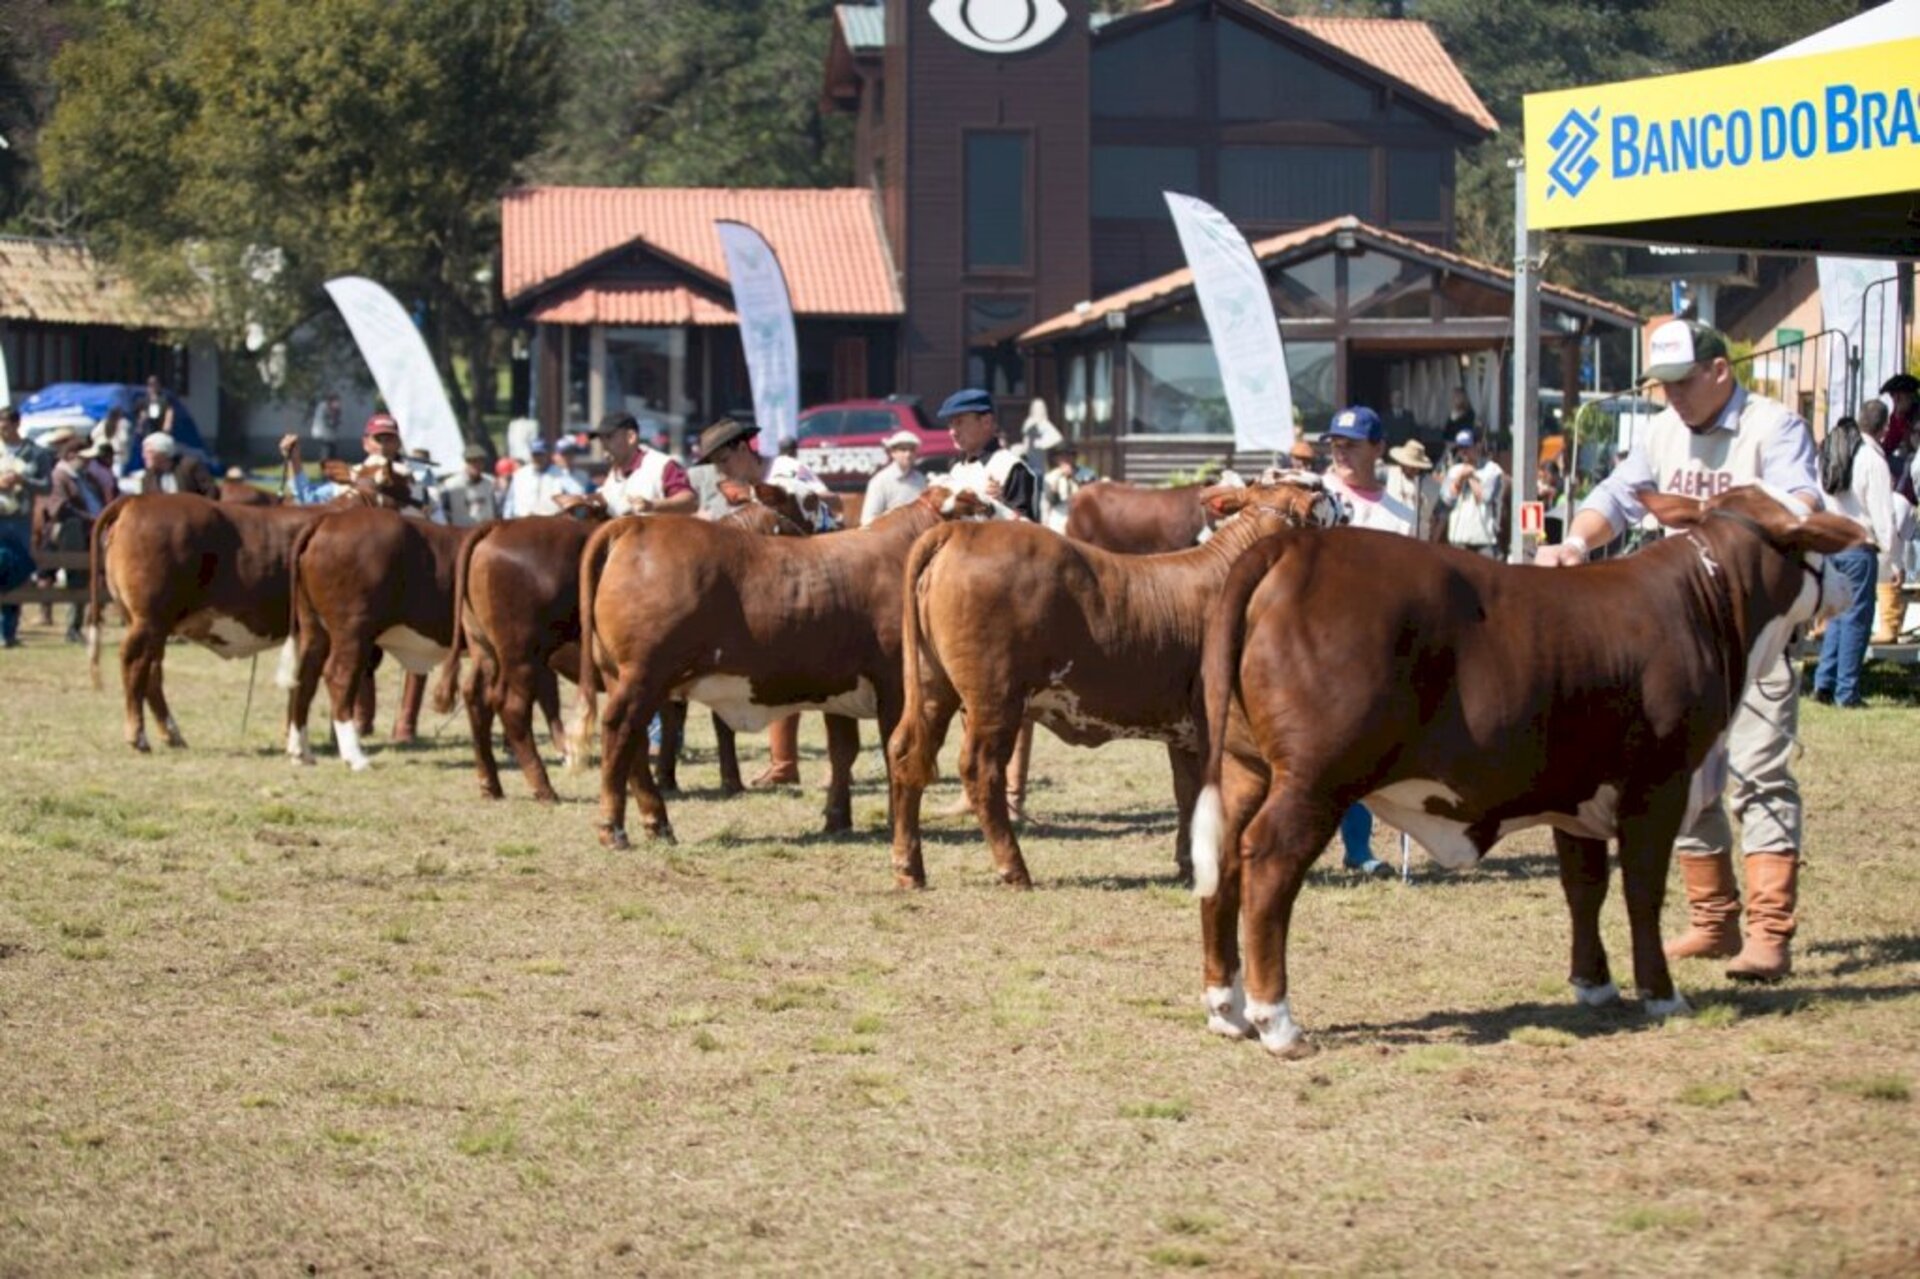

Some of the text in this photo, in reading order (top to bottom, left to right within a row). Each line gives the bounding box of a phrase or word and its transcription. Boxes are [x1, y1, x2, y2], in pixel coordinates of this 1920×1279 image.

[1611, 84, 1920, 179] BANCO DO BRA
